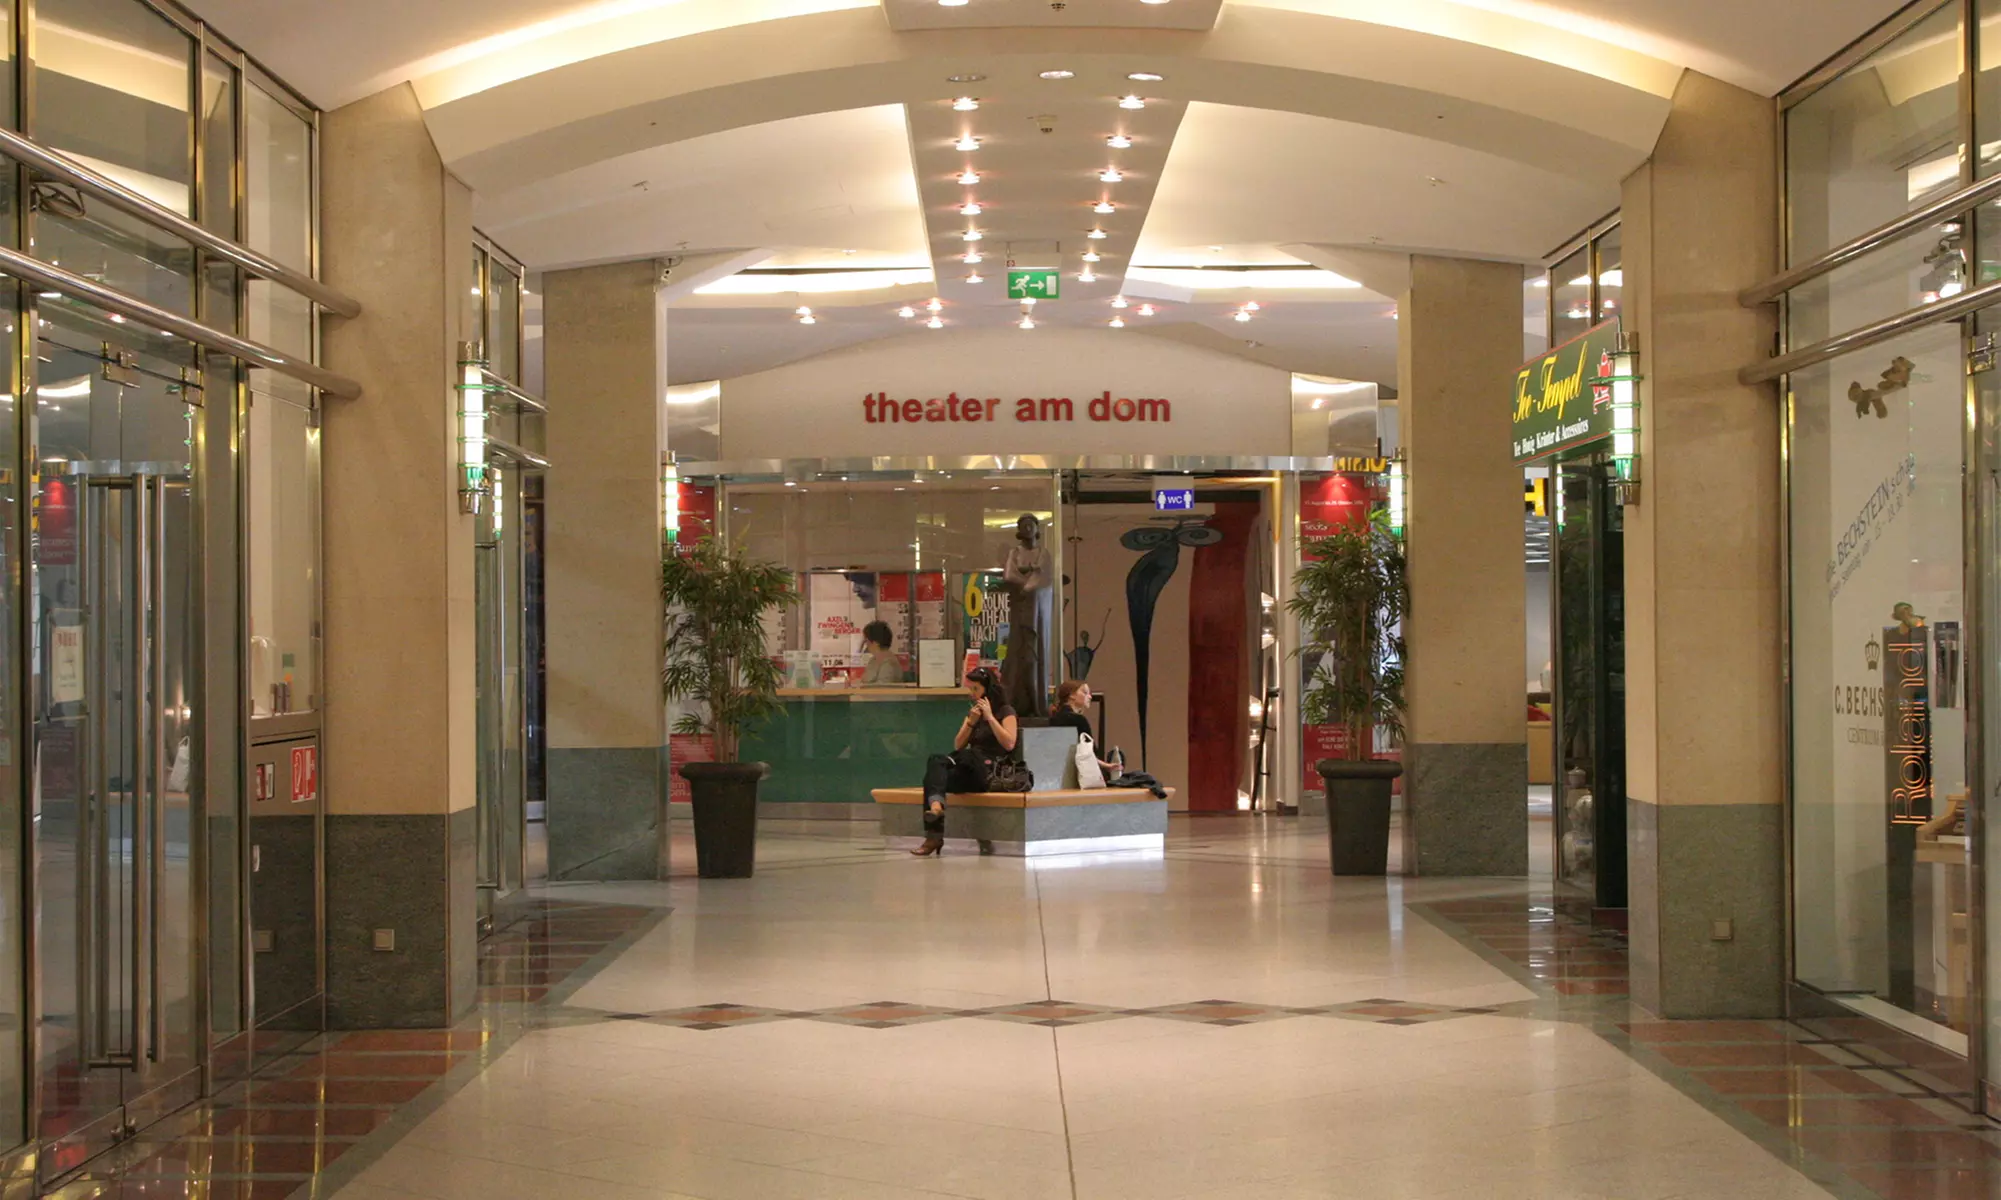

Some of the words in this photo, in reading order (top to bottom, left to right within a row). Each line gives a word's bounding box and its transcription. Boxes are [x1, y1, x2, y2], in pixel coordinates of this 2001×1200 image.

[863, 392, 1000, 423] theater
[1015, 397, 1073, 422] am
[1088, 391, 1171, 422] dom
[1513, 441, 1521, 457] Tee
[1522, 435, 1535, 455] Honig
[1555, 425, 1560, 443] &
[1561, 417, 1589, 440] Accessoires
[1167, 496, 1182, 504] WC
[1837, 477, 1889, 566] BECHSTEIN
[1888, 643, 1926, 825] Roland
